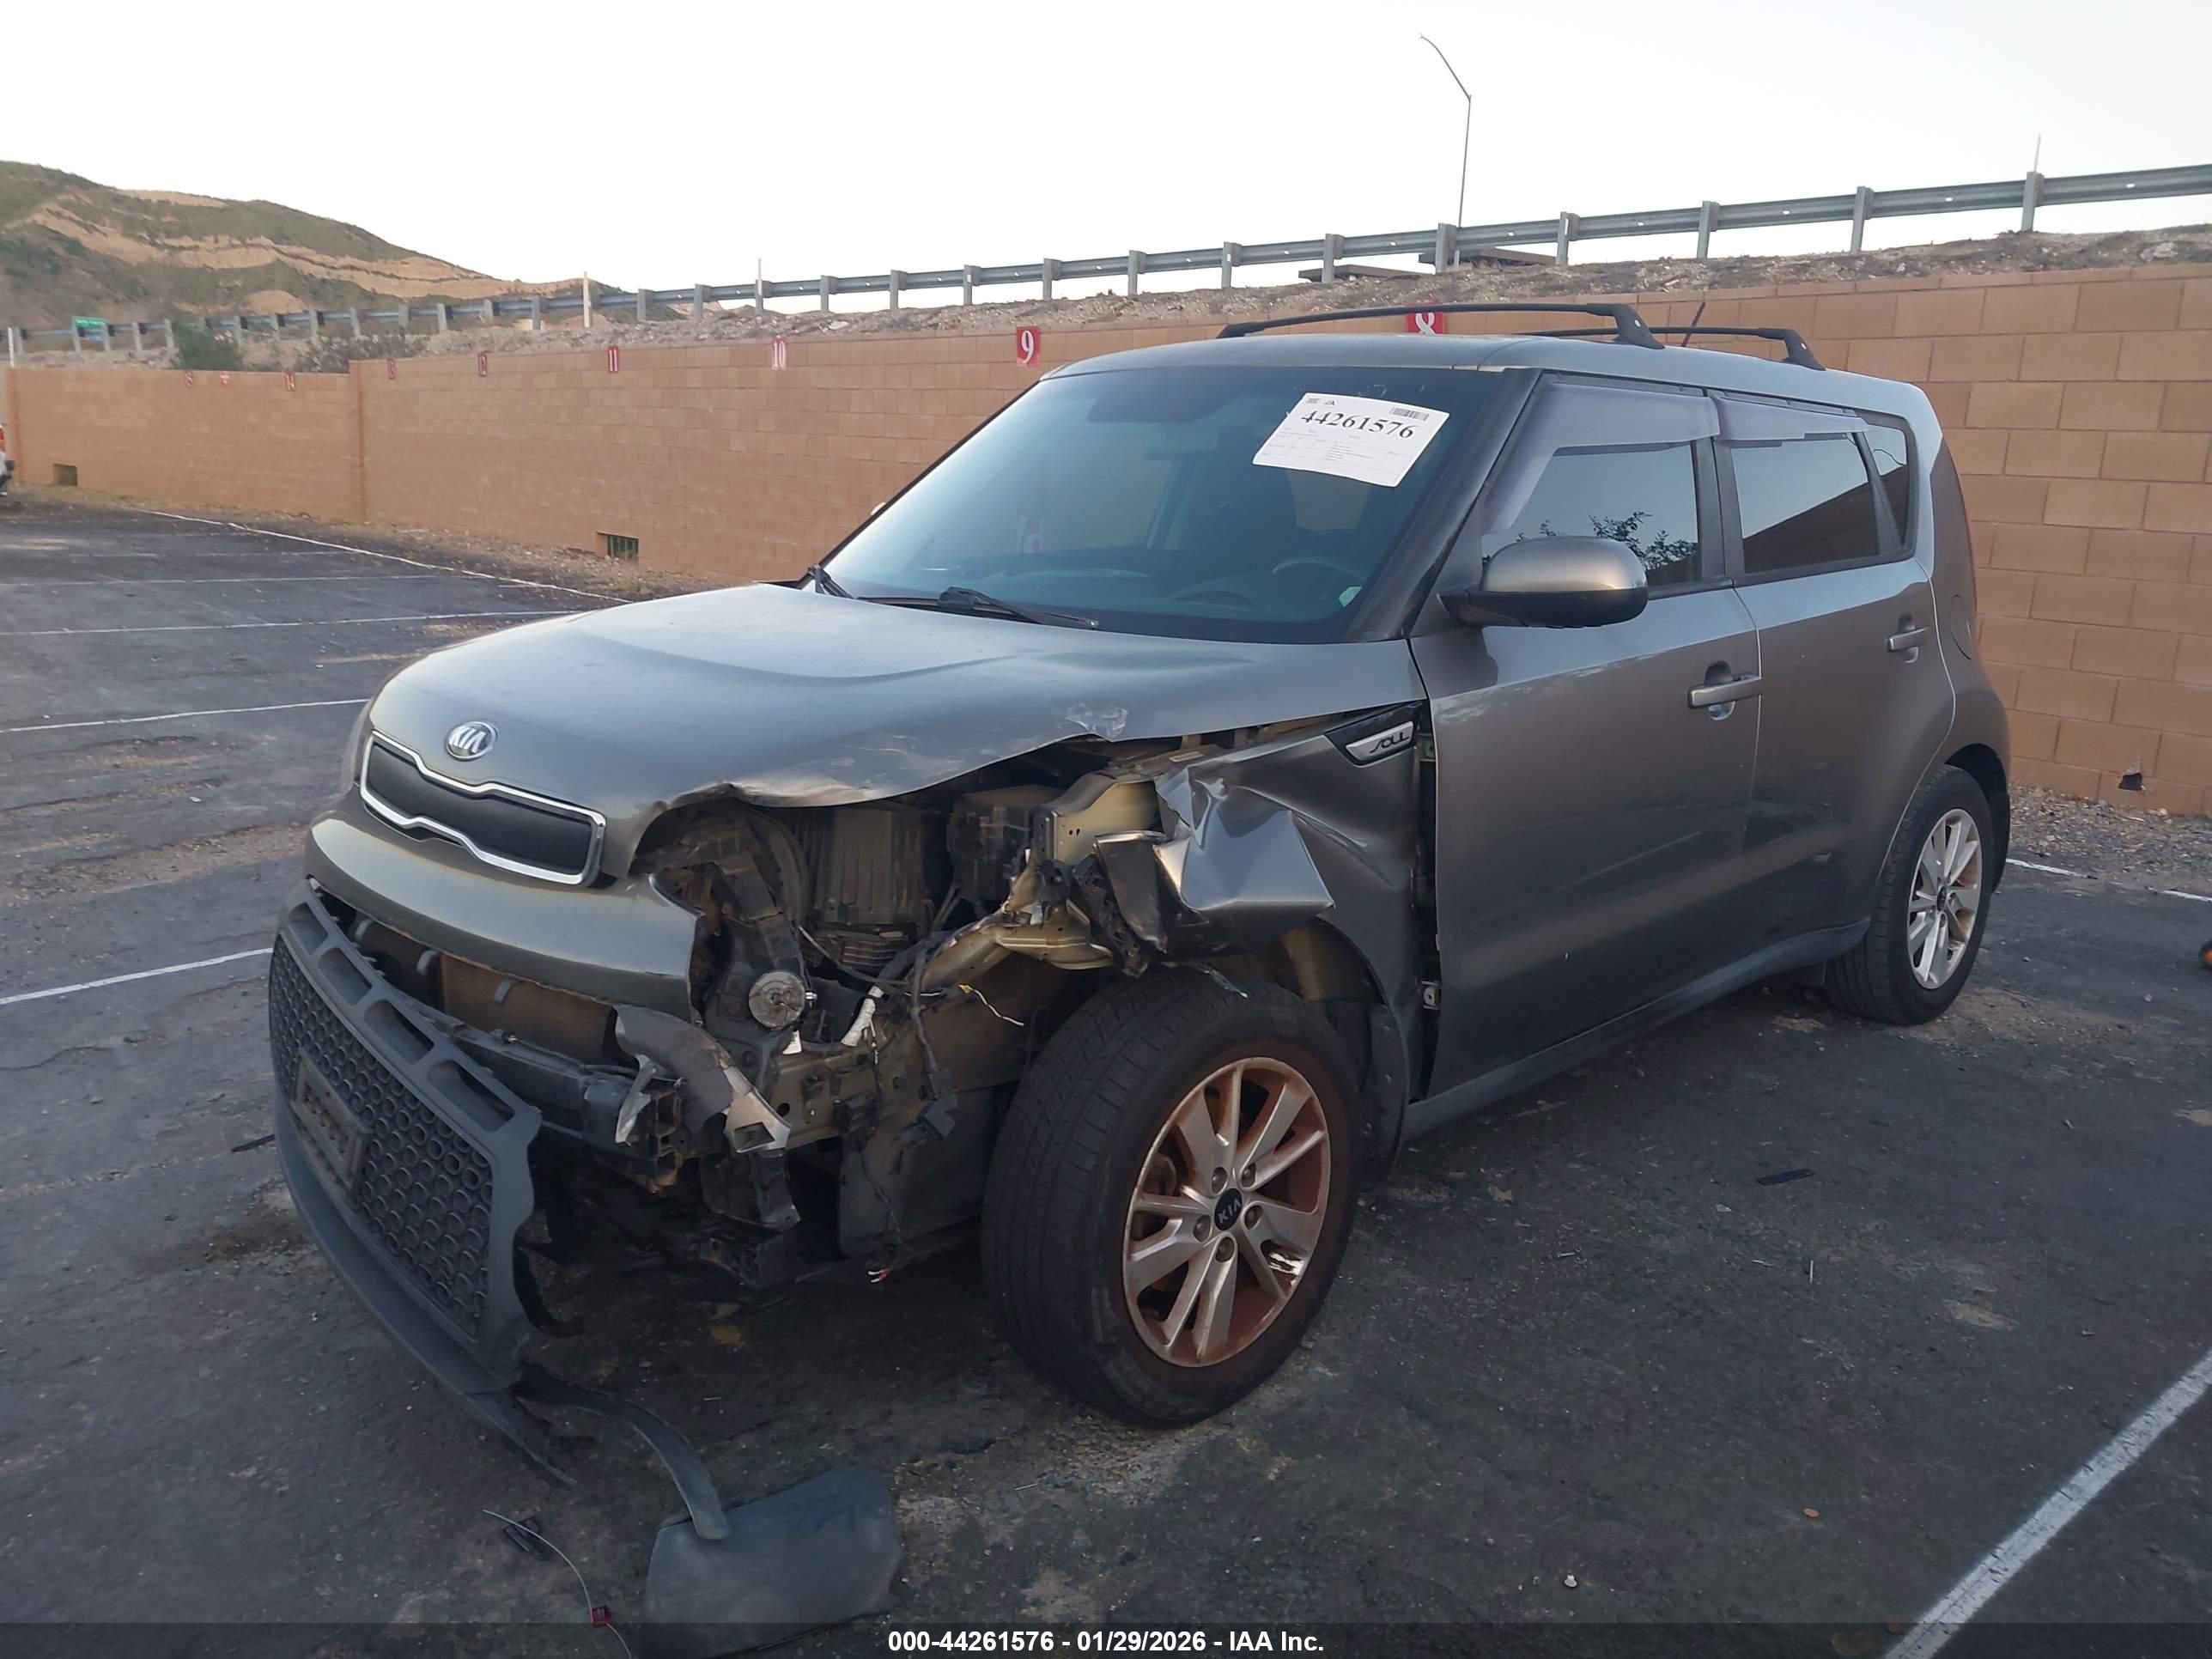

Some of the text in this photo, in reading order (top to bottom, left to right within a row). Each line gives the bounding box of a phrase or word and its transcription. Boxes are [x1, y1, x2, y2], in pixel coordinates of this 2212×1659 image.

[1021, 330, 1035, 363] 9
[1301, 410, 1419, 438] 44261576
[448, 725, 487, 754] KIA
[1218, 1198, 1242, 1224] KIA
